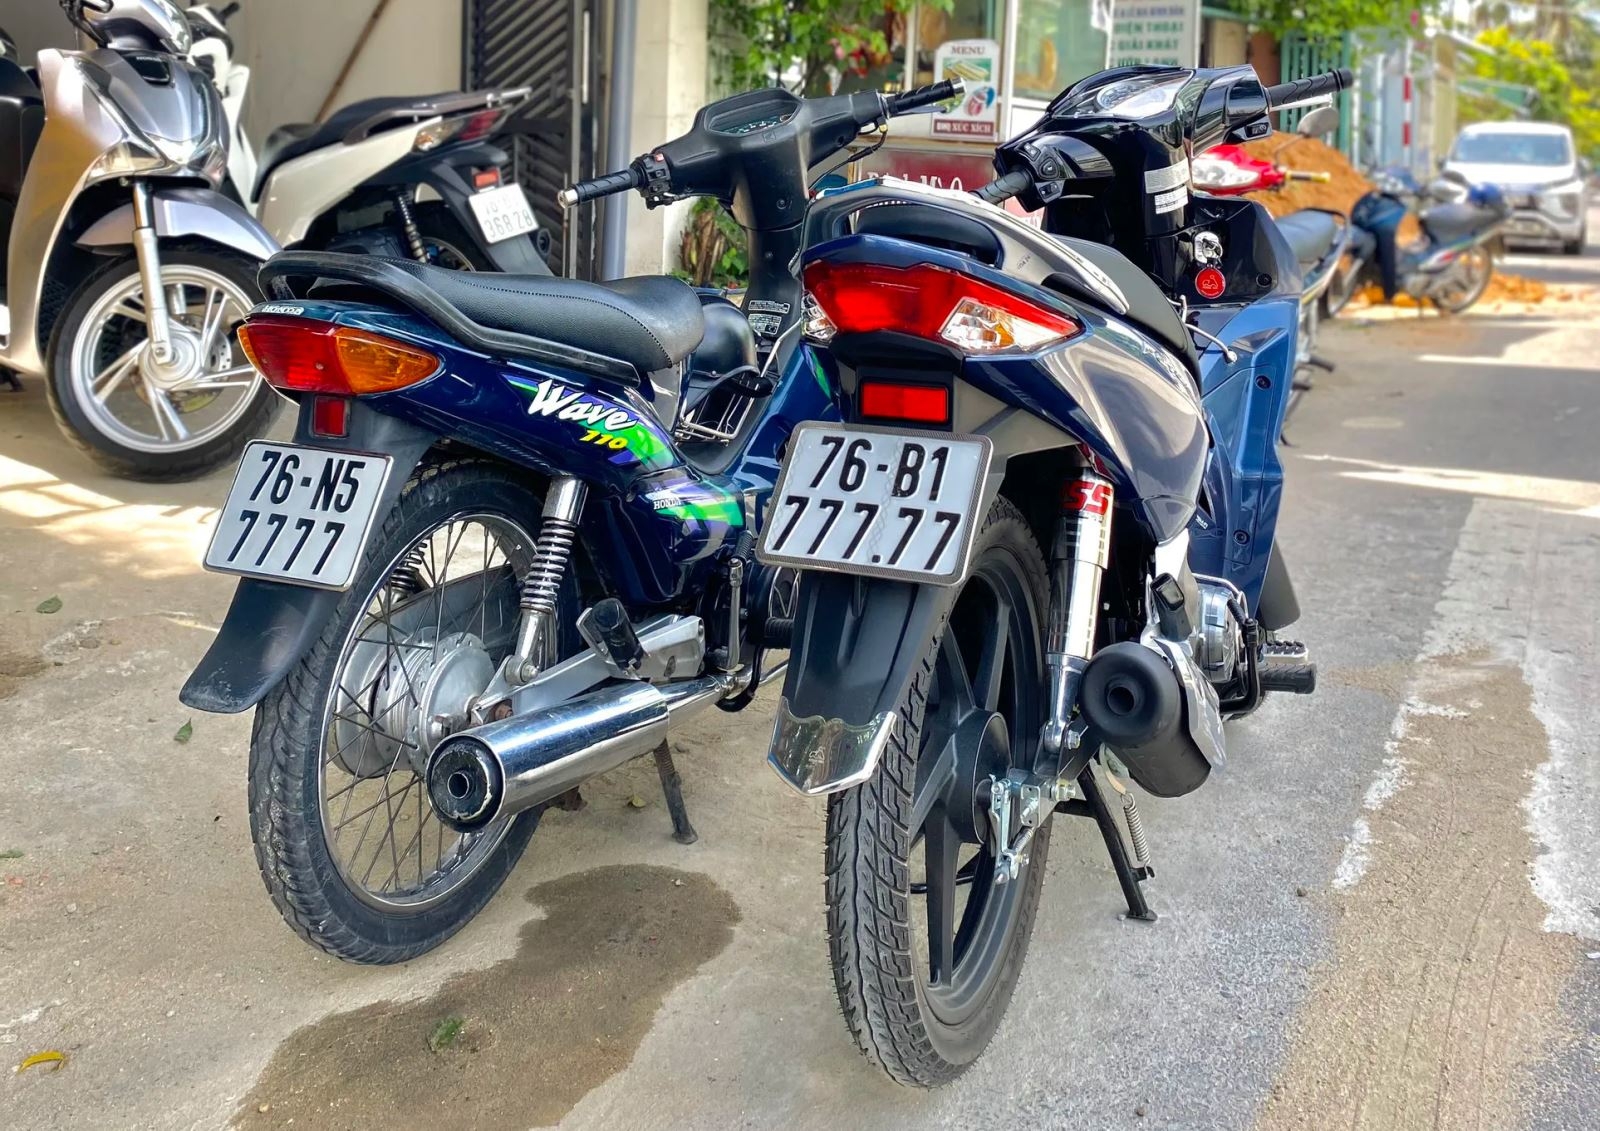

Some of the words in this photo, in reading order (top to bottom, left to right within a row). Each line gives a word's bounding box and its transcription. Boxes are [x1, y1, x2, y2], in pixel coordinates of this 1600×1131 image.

[951, 46, 985, 55] MENU
[527, 379, 637, 431] Wave
[580, 430, 628, 450] 110
[809, 435, 950, 501] 76-B1
[249, 450, 366, 513] 76-N5
[227, 509, 346, 575] 7777
[772, 495, 962, 571] 777.77
